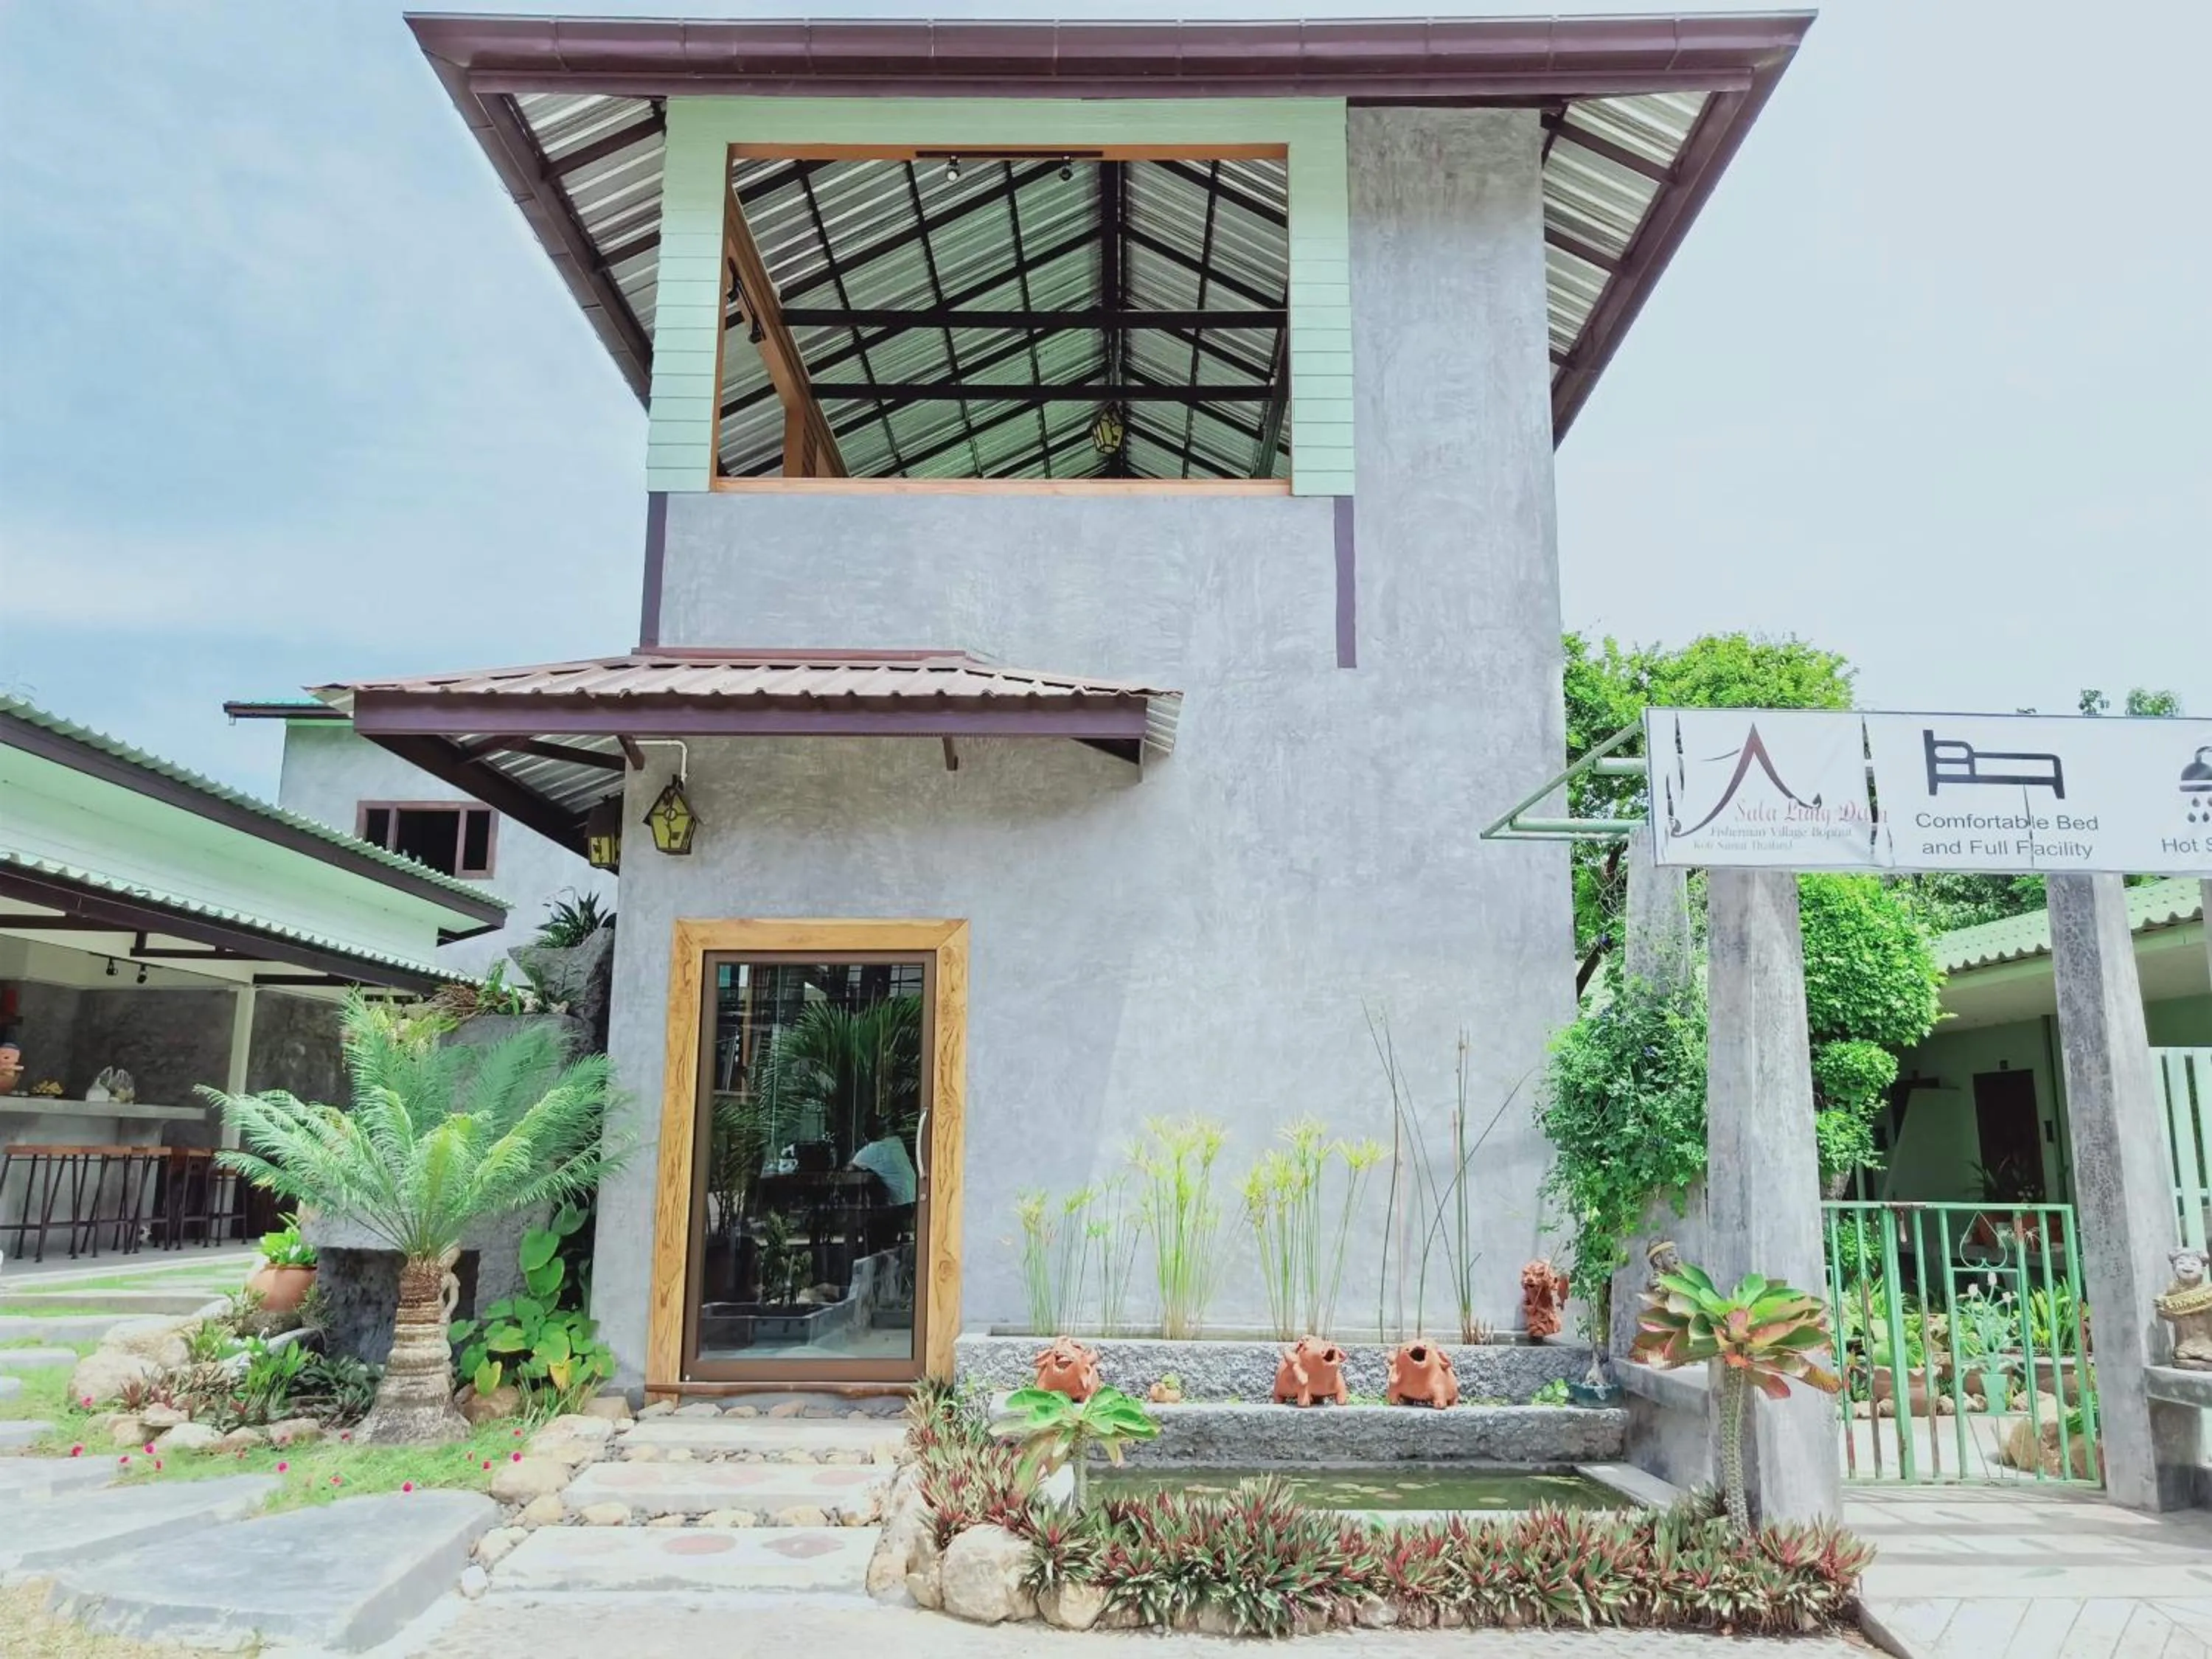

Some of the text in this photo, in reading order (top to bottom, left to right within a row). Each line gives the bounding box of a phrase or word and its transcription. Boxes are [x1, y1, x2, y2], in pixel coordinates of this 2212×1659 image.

[1915, 813, 2098, 830] Comfortable Bed
[1710, 826, 1766, 837] Fisherman
[1770, 825, 1806, 838] Village
[1922, 840, 2093, 860] and Full Facility
[2161, 837, 2199, 853] Hot
